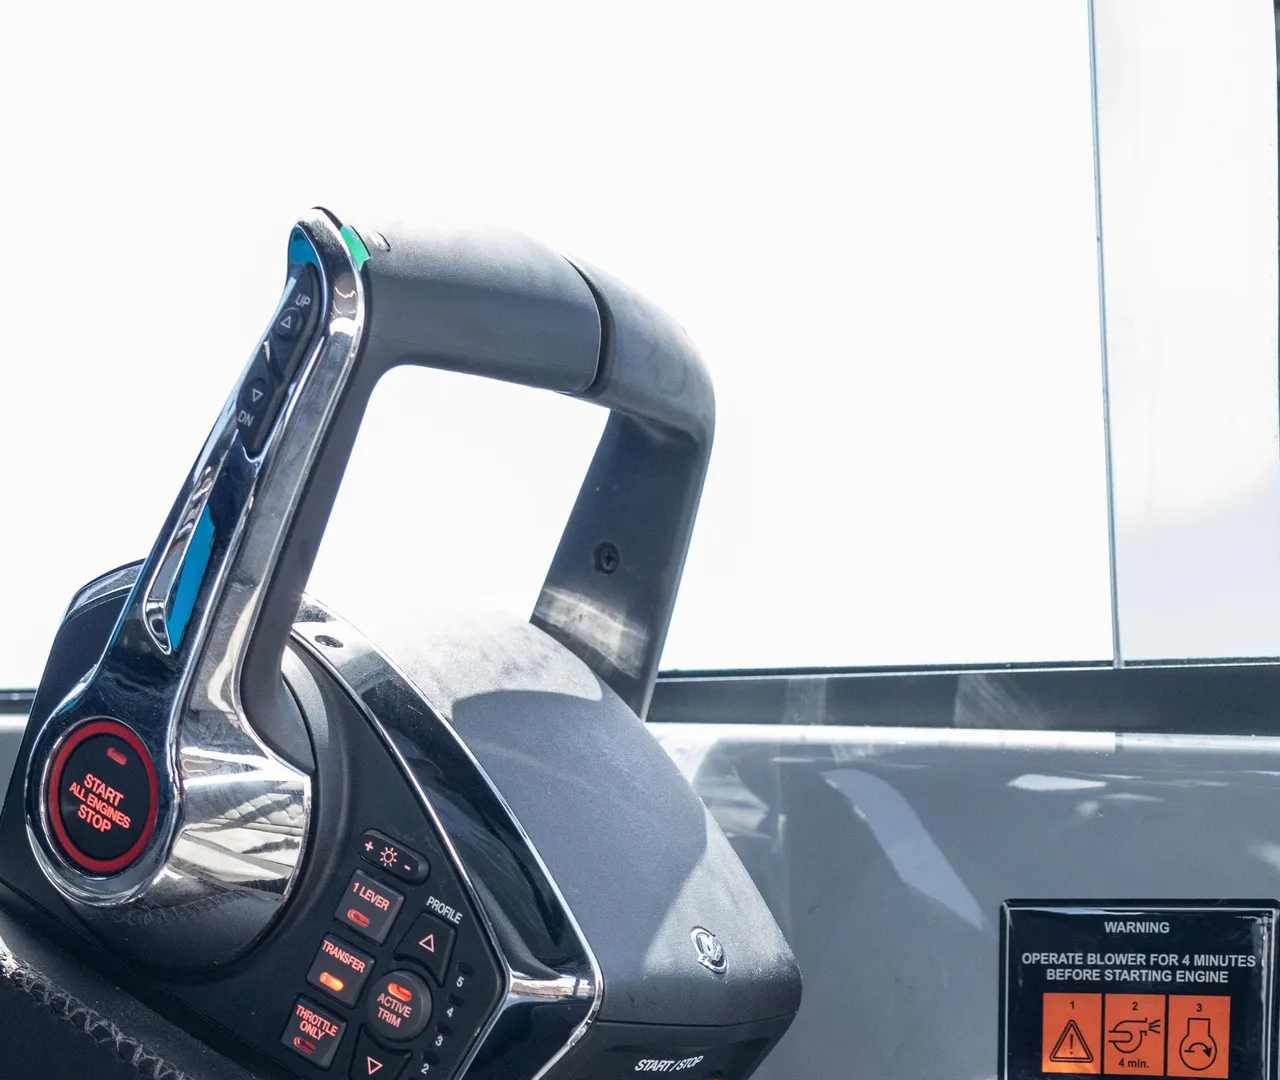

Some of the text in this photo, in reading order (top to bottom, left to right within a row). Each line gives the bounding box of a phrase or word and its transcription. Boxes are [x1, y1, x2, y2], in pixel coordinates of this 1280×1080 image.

[295, 294, 311, 307] UP
[238, 410, 254, 427] DN
[84, 773, 124, 806] START
[69, 782, 131, 828] ALL ENGINES
[78, 805, 111, 832] STOP
[359, 887, 390, 912] LEVER
[426, 896, 463, 924] PROFILE
[1105, 921, 1170, 934] WARNING
[322, 940, 366, 972] TRANSFER
[1022, 953, 1256, 967] OPERATE BLOWER FOR 4 MINUTES
[1046, 969, 1228, 983] BEFORE STARTING ENGINE
[377, 993, 412, 1018] ACTIVE
[295, 1004, 338, 1036] THROTTLE
[377, 1008, 401, 1028] TRIM
[299, 1021, 325, 1041] ONLY
[1128, 1059, 1149, 1068] min.
